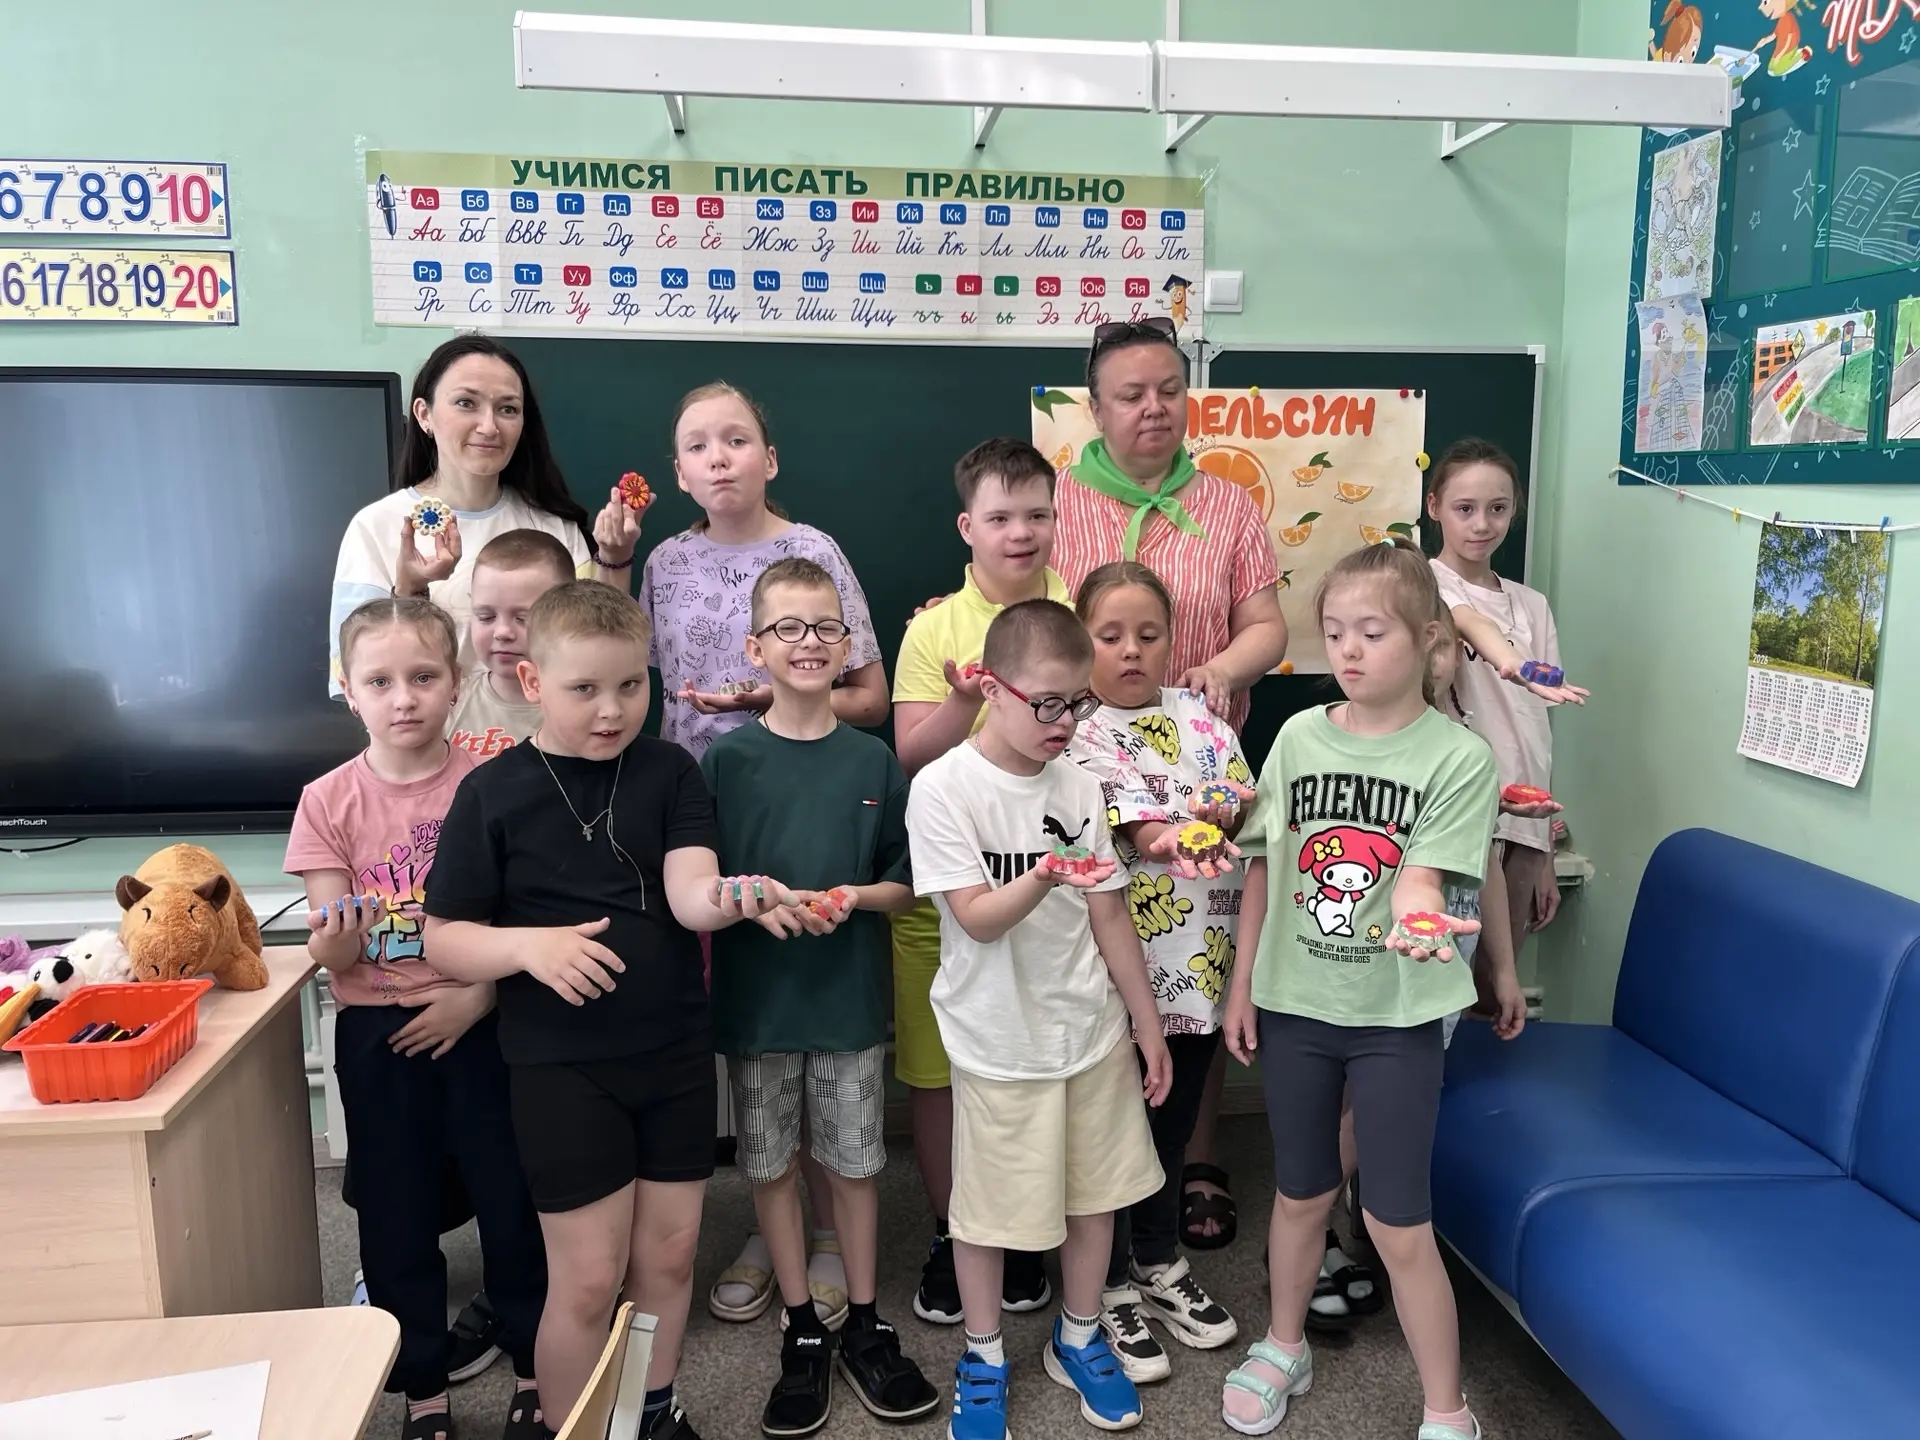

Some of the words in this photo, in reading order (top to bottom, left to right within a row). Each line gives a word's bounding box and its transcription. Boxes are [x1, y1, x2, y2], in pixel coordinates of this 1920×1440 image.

[0, 172, 23, 219] 6
[35, 173, 64, 219] 7
[80, 172, 108, 221] 8
[120, 174, 150, 222] 9
[158, 174, 211, 223] 10
[511, 159, 671, 190] УЧИМСЯ
[714, 166, 868, 196] ПИСАТЬ
[906, 172, 1125, 203] ПРАВИЛЬНО
[416, 194, 434, 206] Аа
[467, 195, 484, 207] Бб
[516, 197, 533, 209] Вв
[564, 198, 578, 210] Гг
[608, 200, 627, 213] Дд
[657, 201, 674, 213] Ее
[702, 201, 719, 215] Ёё
[758, 204, 782, 217] Жж
[815, 206, 831, 218] Зз
[857, 207, 874, 219] Ии
[901, 206, 919, 220] Йй
[946, 209, 961, 221] Кк
[989, 210, 1006, 222] Лл
[1038, 212, 1058, 224] Мм
[1088, 214, 1104, 226] Нн
[1125, 215, 1142, 226] Оо
[1165, 215, 1181, 227] Пп
[0, 263, 25, 305] 6
[33, 263, 70, 305] 17
[79, 263, 119, 307] 18
[126, 264, 166, 307] 19
[174, 265, 219, 308] 20
[419, 266, 437, 280] Рр
[470, 267, 488, 279] Сс
[520, 269, 536, 281] Тт
[569, 270, 585, 284] Уу
[612, 271, 635, 286] Фф
[667, 273, 683, 285] Хх
[713, 275, 731, 288] Цц
[759, 276, 776, 288] Чч
[804, 277, 827, 289] Шш
[861, 278, 884, 291] Щщ
[1041, 282, 1056, 293] Ээ
[1083, 282, 1104, 293] Юю
[1129, 283, 1145, 294] Яя
[1187, 394, 1375, 440] ЕЛЬСИН
[1296, 934, 1322, 949] SPREADING
[1324, 943, 1335, 952] JOY
[1336, 945, 1349, 954] AND
[1308, 948, 1340, 961] WHEREVER
[1341, 954, 1353, 962] SHE
[1354, 955, 1370, 963] GOES
